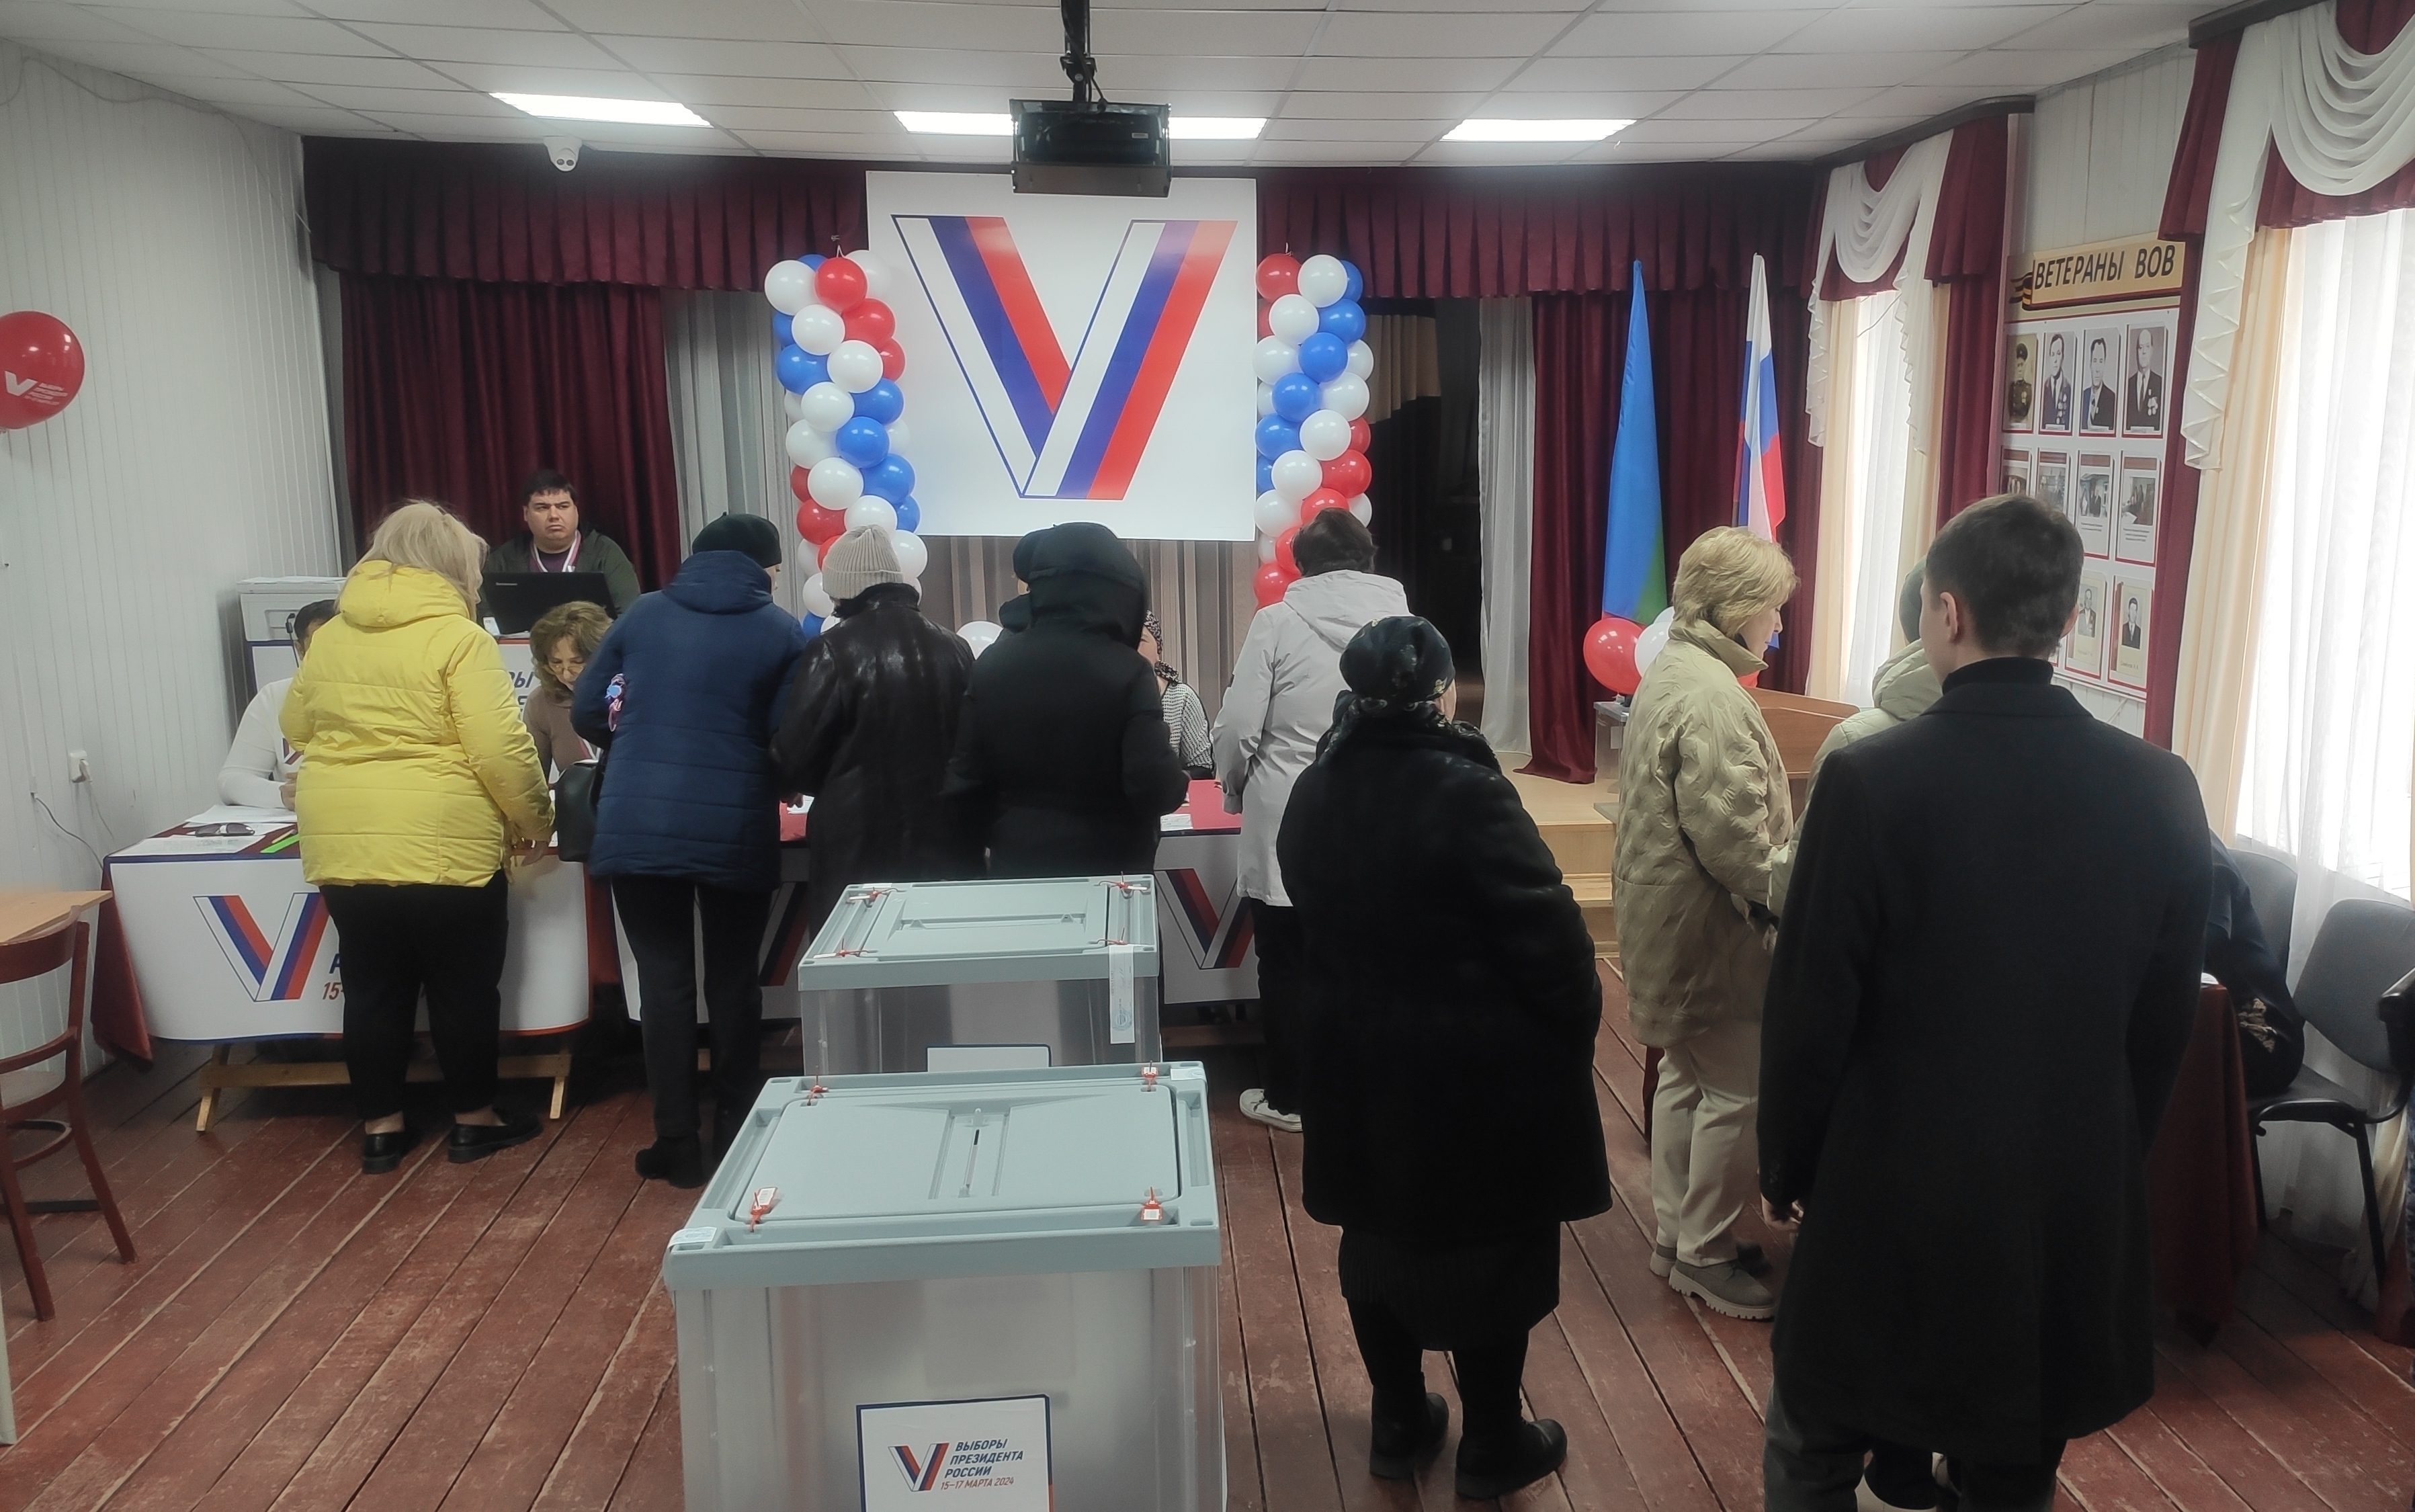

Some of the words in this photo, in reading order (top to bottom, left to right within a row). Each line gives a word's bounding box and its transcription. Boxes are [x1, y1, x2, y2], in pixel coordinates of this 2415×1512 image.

[2034, 251, 2125, 290] ВЕТЕРАНЫ
[2134, 245, 2176, 279] ВОВ
[955, 1439, 1008, 1452] ВЫБОРЫ
[949, 1451, 1024, 1466] ПРЕЗИДЕНТА
[945, 1466, 992, 1478] РОССИИ
[965, 1479, 993, 1489] МАРТА
[994, 1477, 1015, 1486] 2024
